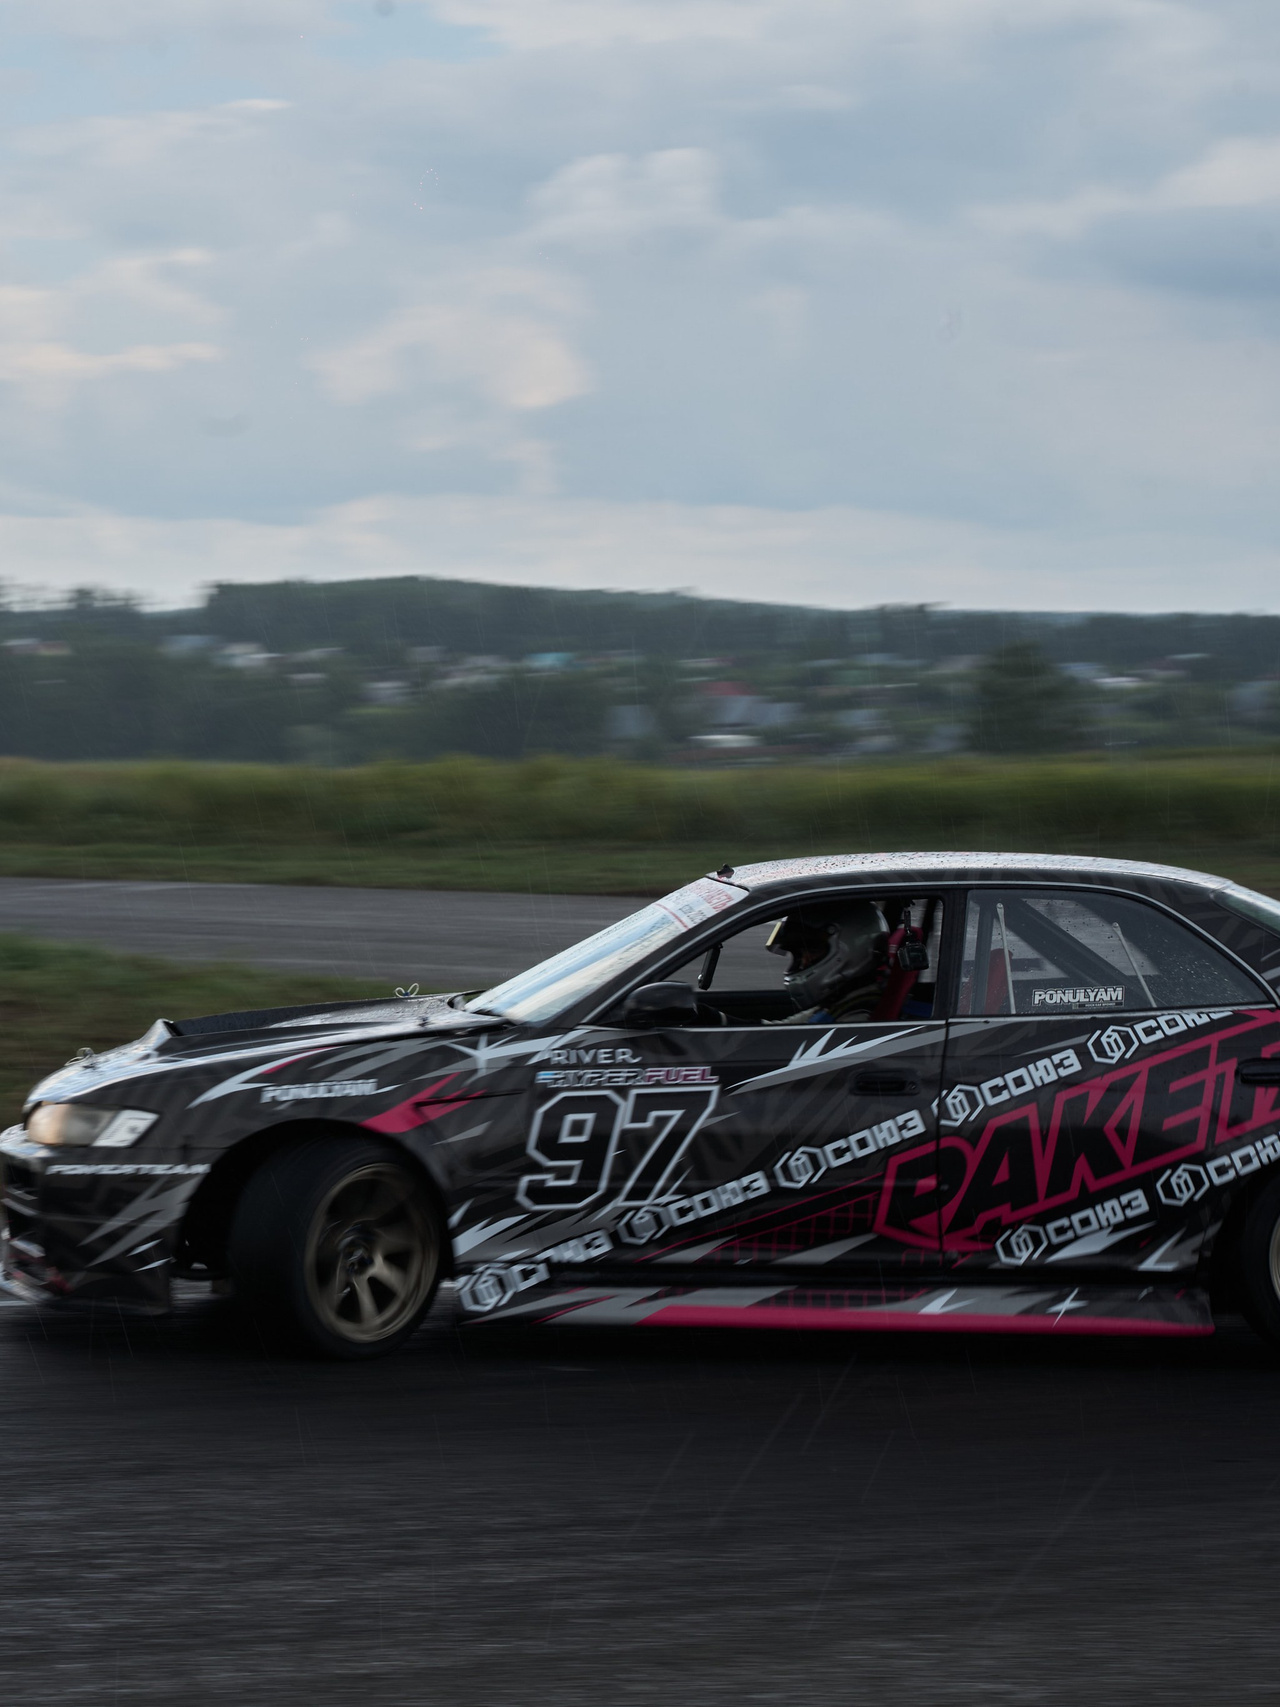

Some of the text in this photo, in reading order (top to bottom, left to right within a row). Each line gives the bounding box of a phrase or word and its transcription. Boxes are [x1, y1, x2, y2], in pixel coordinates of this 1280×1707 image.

[1033, 986, 1123, 1005] PONULYAM
[551, 1049, 642, 1064] RIVER
[516, 1085, 720, 1211] 97
[668, 1170, 771, 1227] СОЮЗ
[823, 1109, 927, 1168] СОЮЗ
[980, 1048, 1082, 1106] СОЮЗ
[1046, 1133, 1280, 1245] СОЮЗ СОЮ
